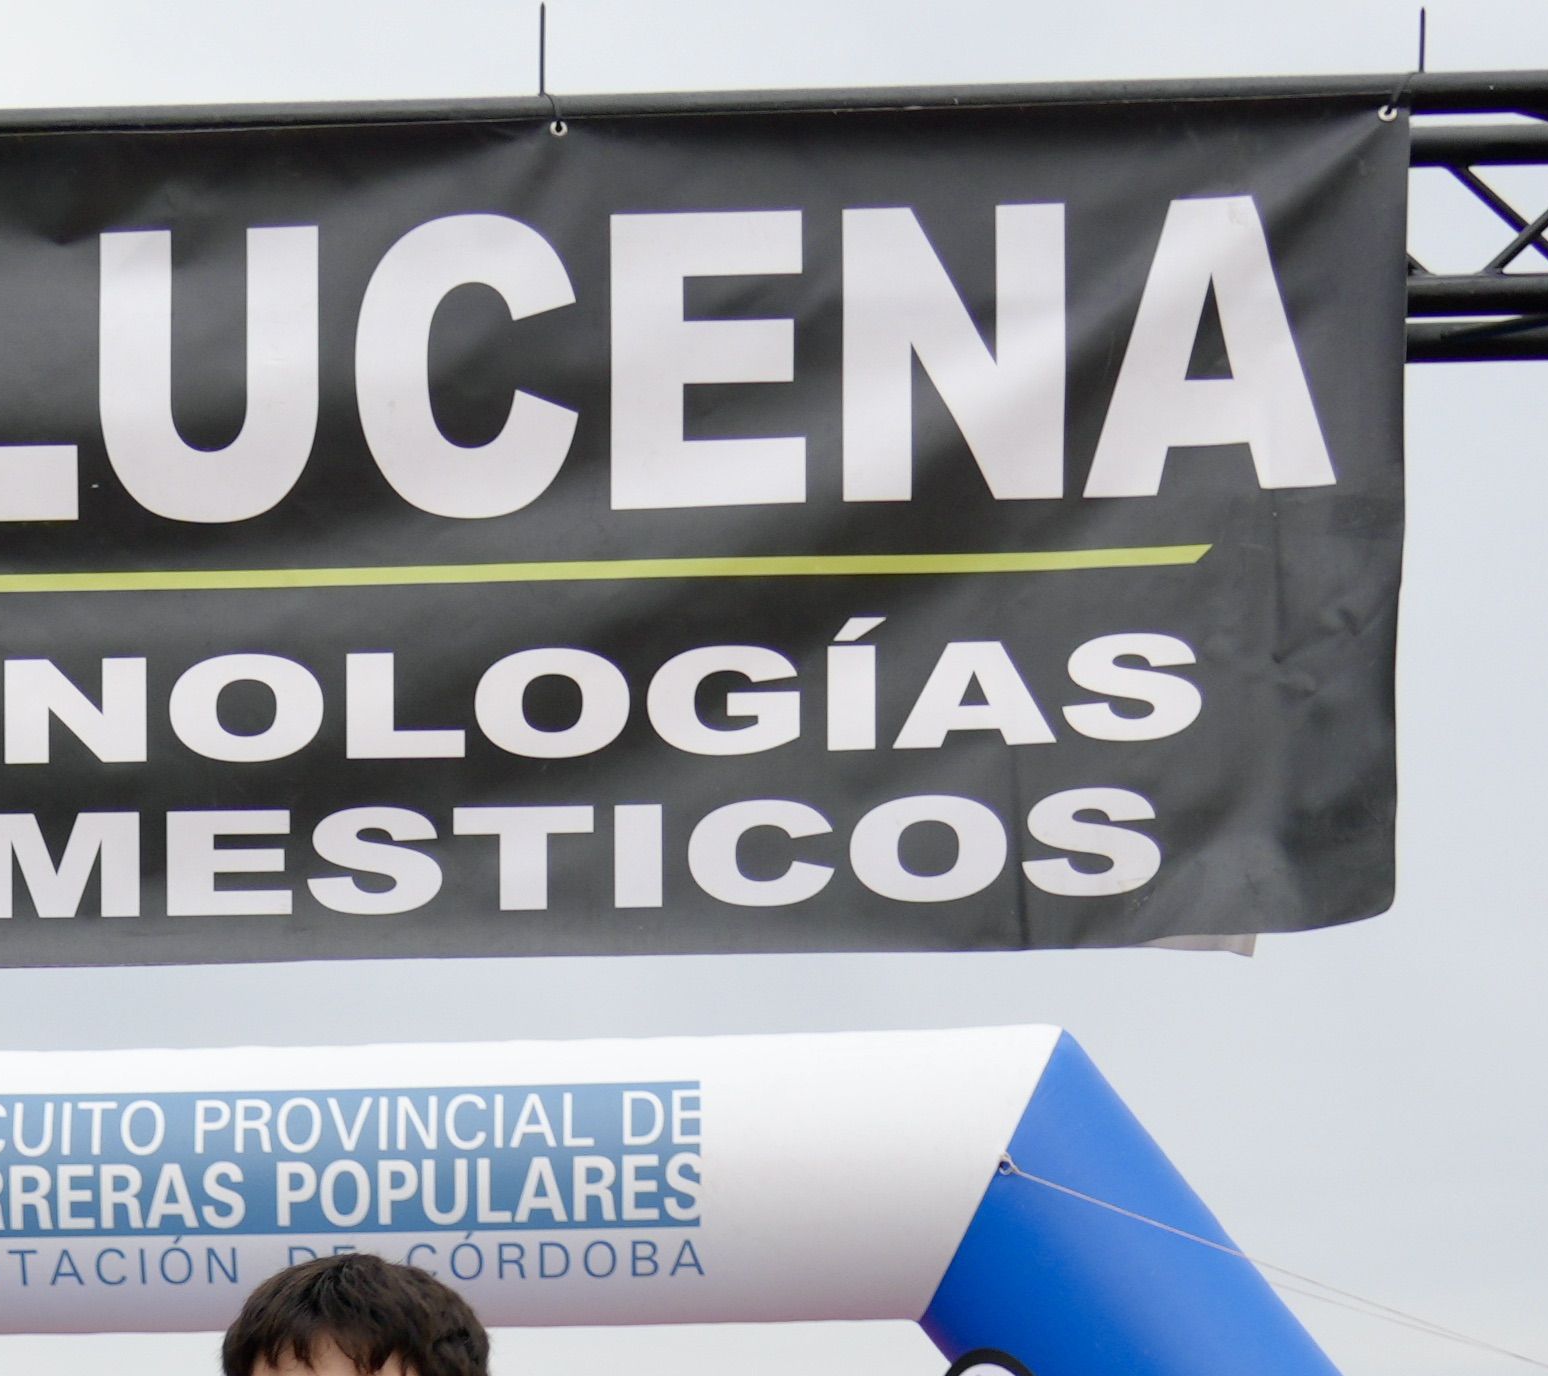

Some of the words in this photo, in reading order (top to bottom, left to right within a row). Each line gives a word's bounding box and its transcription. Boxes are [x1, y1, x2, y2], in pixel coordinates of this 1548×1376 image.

[193, 1091, 595, 1156] PROVINCIAL
[621, 1088, 702, 1147] DE
[277, 1152, 703, 1227] POPULARES
[406, 1231, 705, 1281] CÓRDOBA
